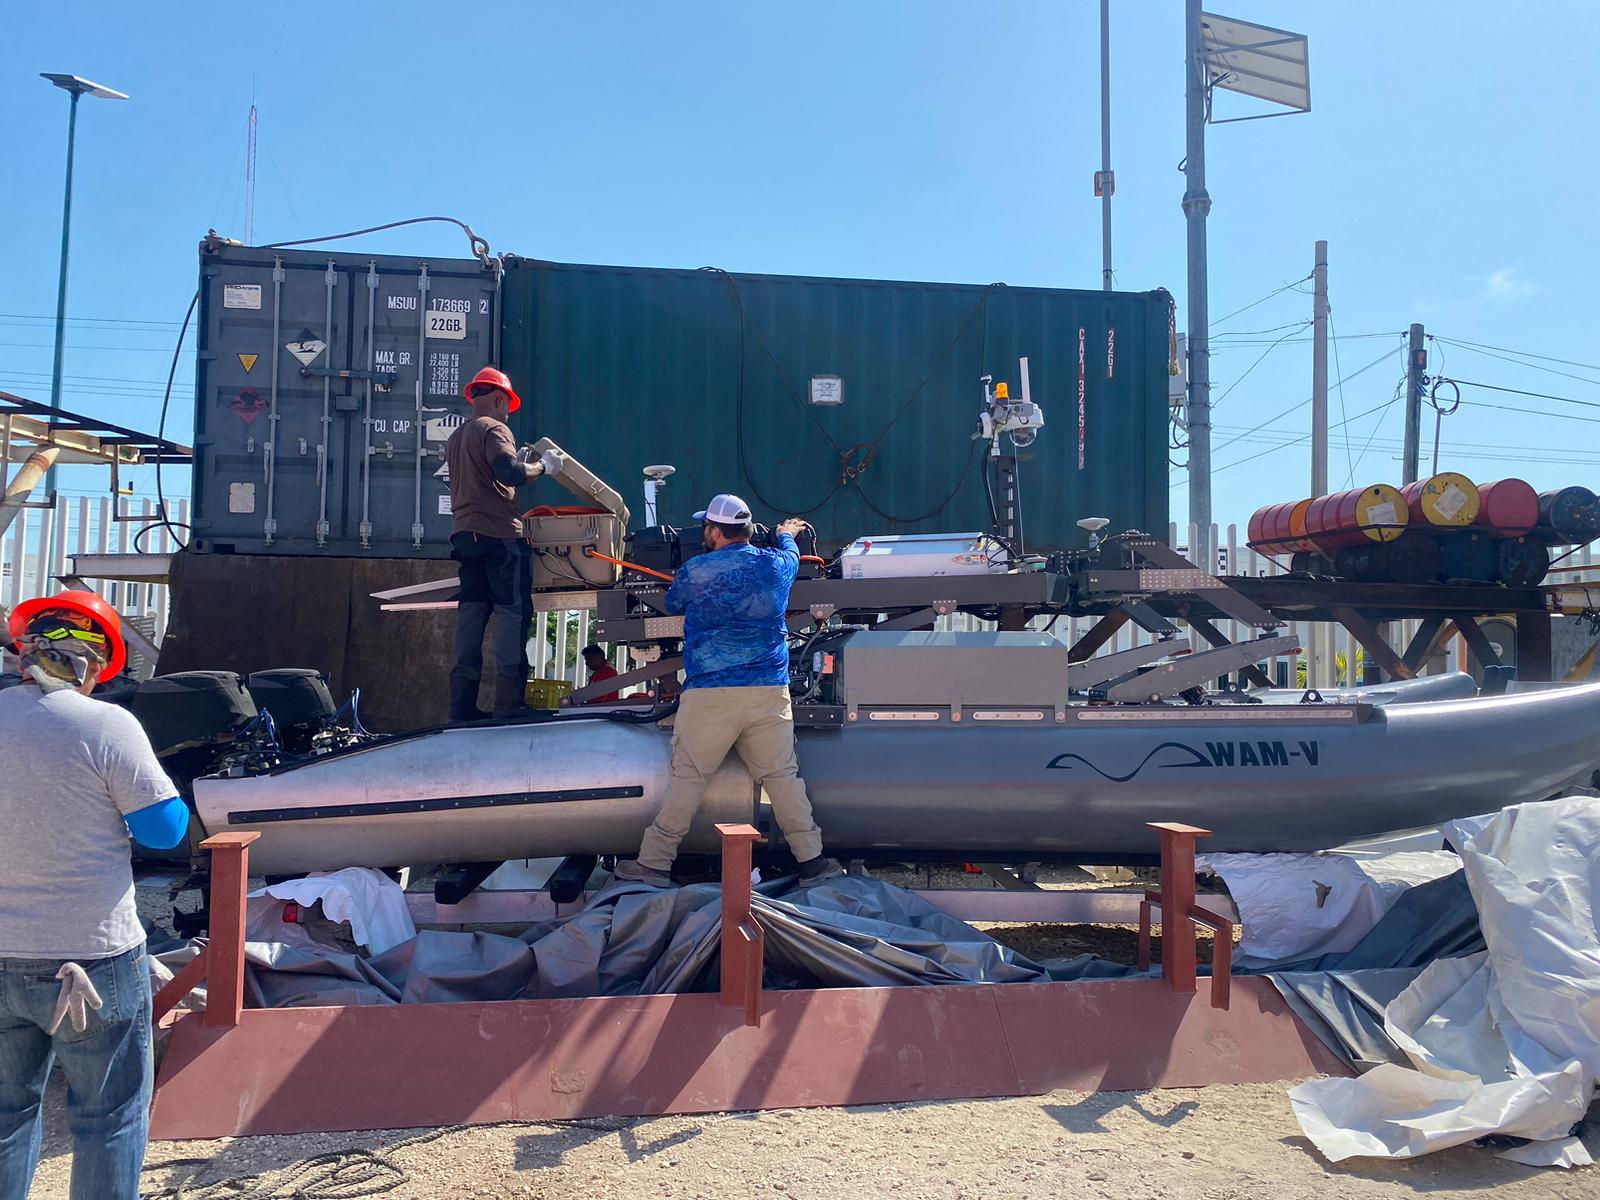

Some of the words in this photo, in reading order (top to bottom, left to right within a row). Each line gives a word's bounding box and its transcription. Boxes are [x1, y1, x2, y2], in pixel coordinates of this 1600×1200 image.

[387, 296, 417, 310] MSUU
[431, 299, 471, 313] 173669
[480, 300, 488, 314] 2
[375, 351, 397, 365] MAX.
[399, 352, 414, 365] GR.
[374, 420, 389, 432] CU.
[1204, 741, 1318, 767] WAM-V
